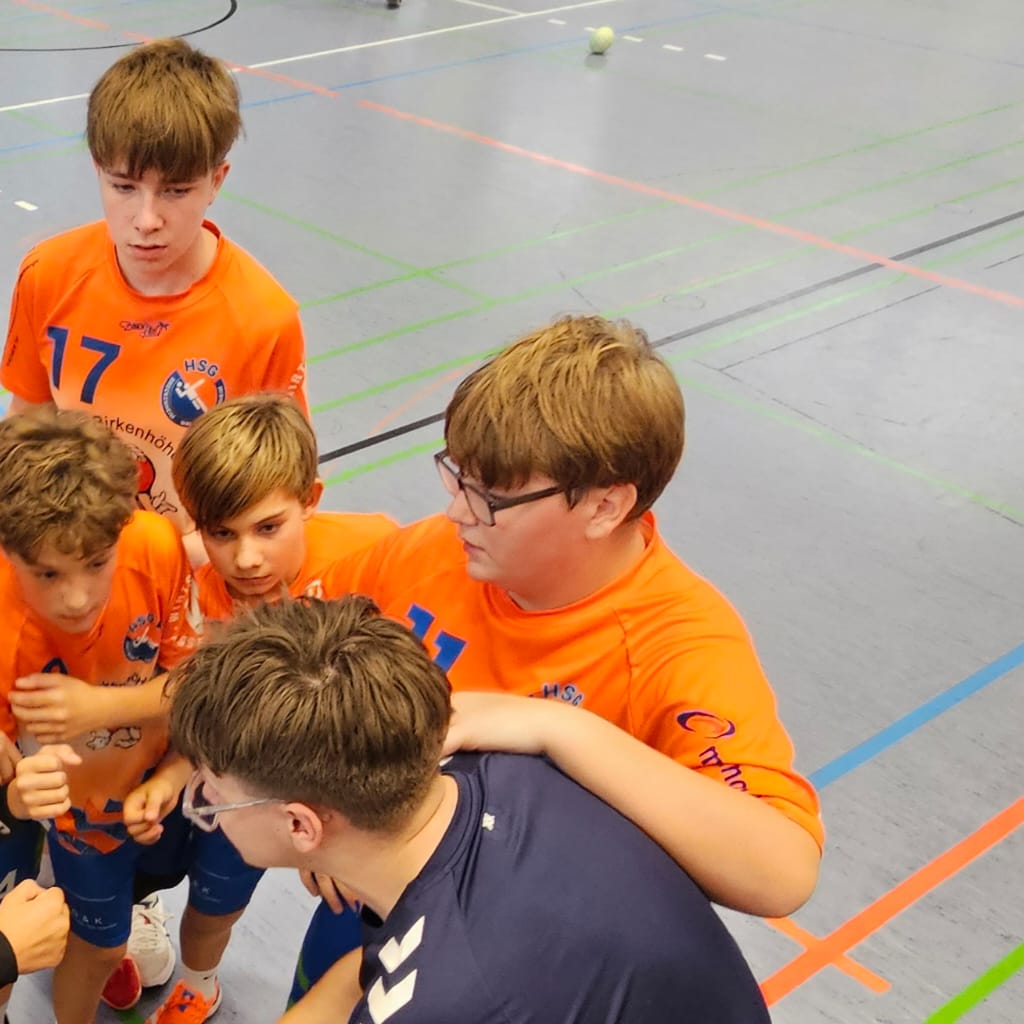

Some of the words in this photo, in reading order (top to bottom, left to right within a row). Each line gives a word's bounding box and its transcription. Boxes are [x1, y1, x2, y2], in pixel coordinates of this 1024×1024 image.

[47, 325, 121, 405] 17
[183, 359, 218, 377] HSG
[93, 415, 176, 458] irkenhöh
